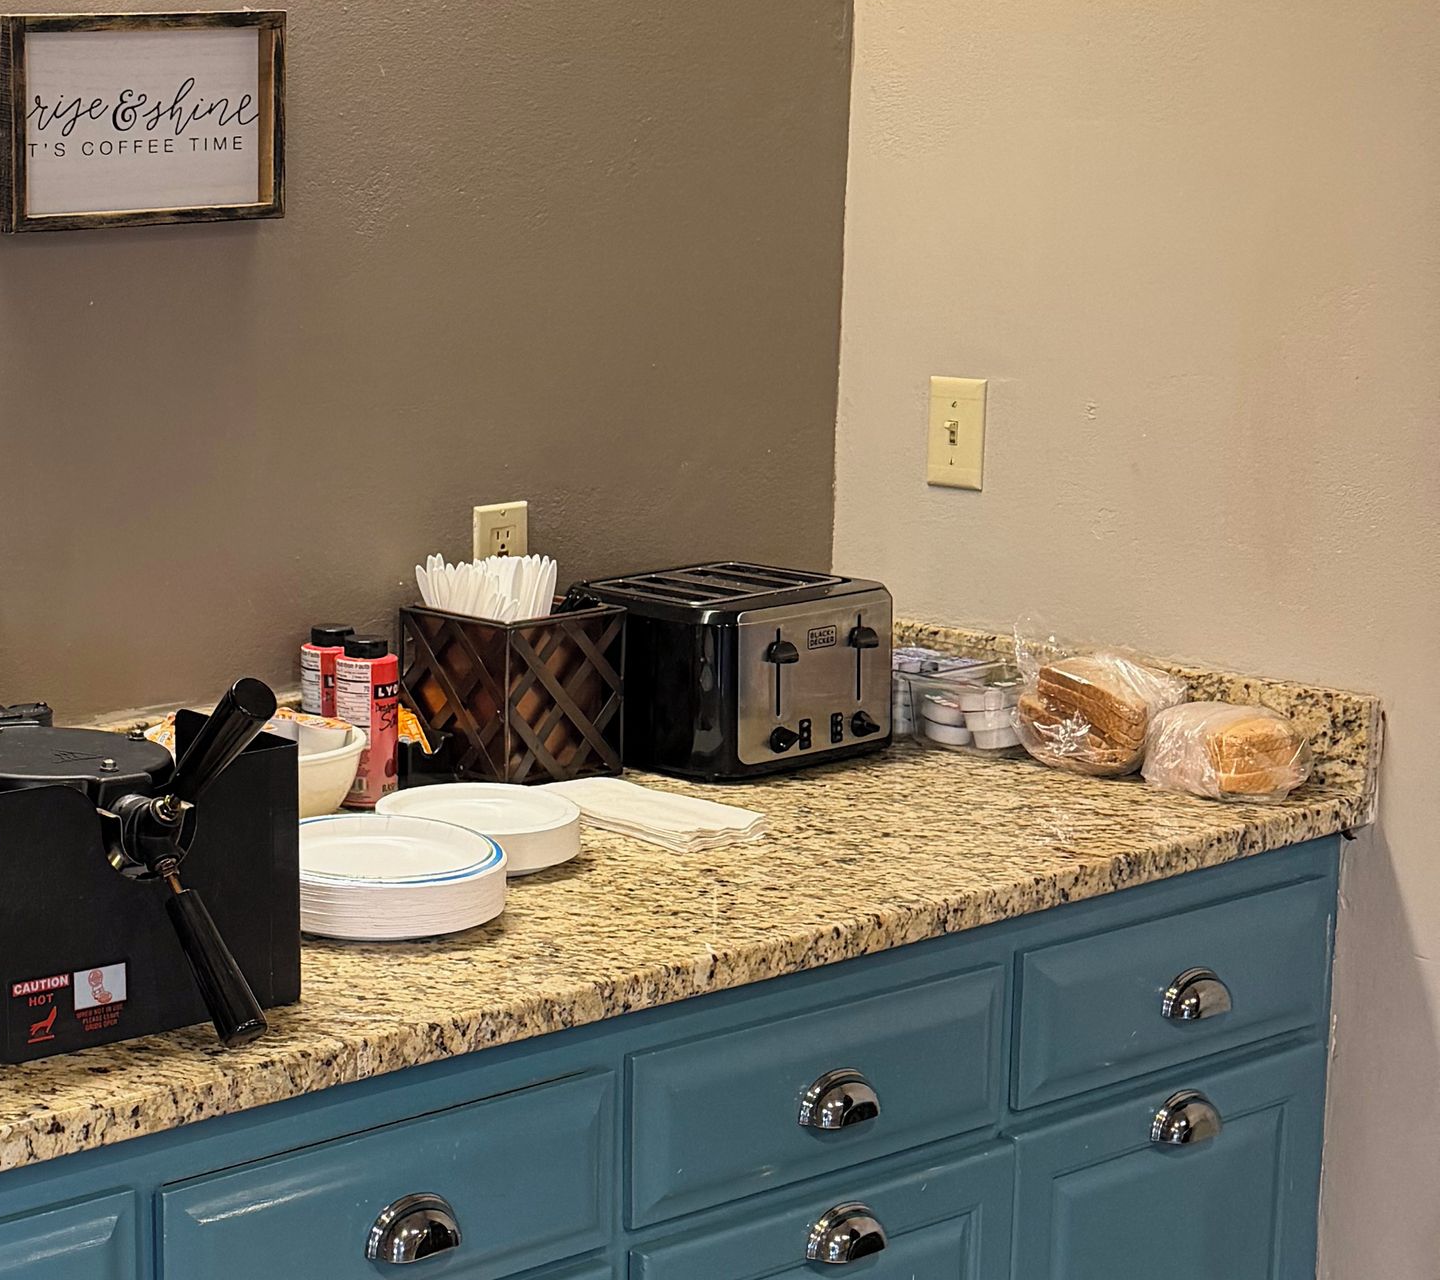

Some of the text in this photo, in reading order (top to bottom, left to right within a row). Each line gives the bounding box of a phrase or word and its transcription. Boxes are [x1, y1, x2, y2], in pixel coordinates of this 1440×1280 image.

[27, 94, 109, 136] rise
[142, 77, 259, 135] shine
[28, 136, 243, 157] T'S COFFEE TIME
[810, 636, 834, 647] DECKER
[378, 684, 398, 697] LYO
[13, 974, 70, 995] CAUTION
[28, 993, 54, 1007] HOT
